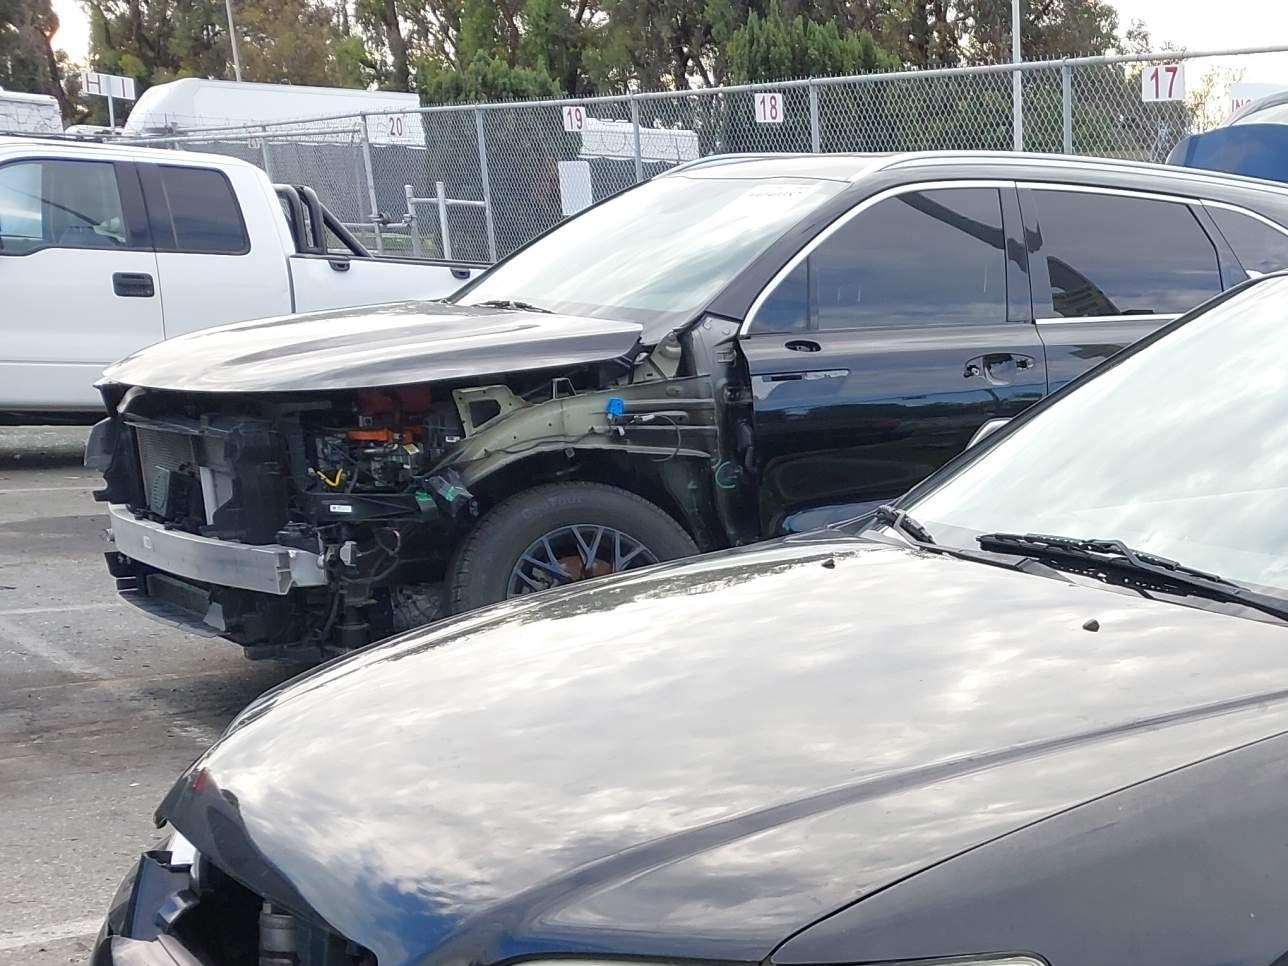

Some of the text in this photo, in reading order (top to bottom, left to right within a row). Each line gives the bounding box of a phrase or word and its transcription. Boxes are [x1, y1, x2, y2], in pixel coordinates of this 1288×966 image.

[1150, 66, 1178, 99] 17
[566, 107, 583, 130] 19
[760, 95, 778, 121] 18
[389, 116, 403, 137] 20
